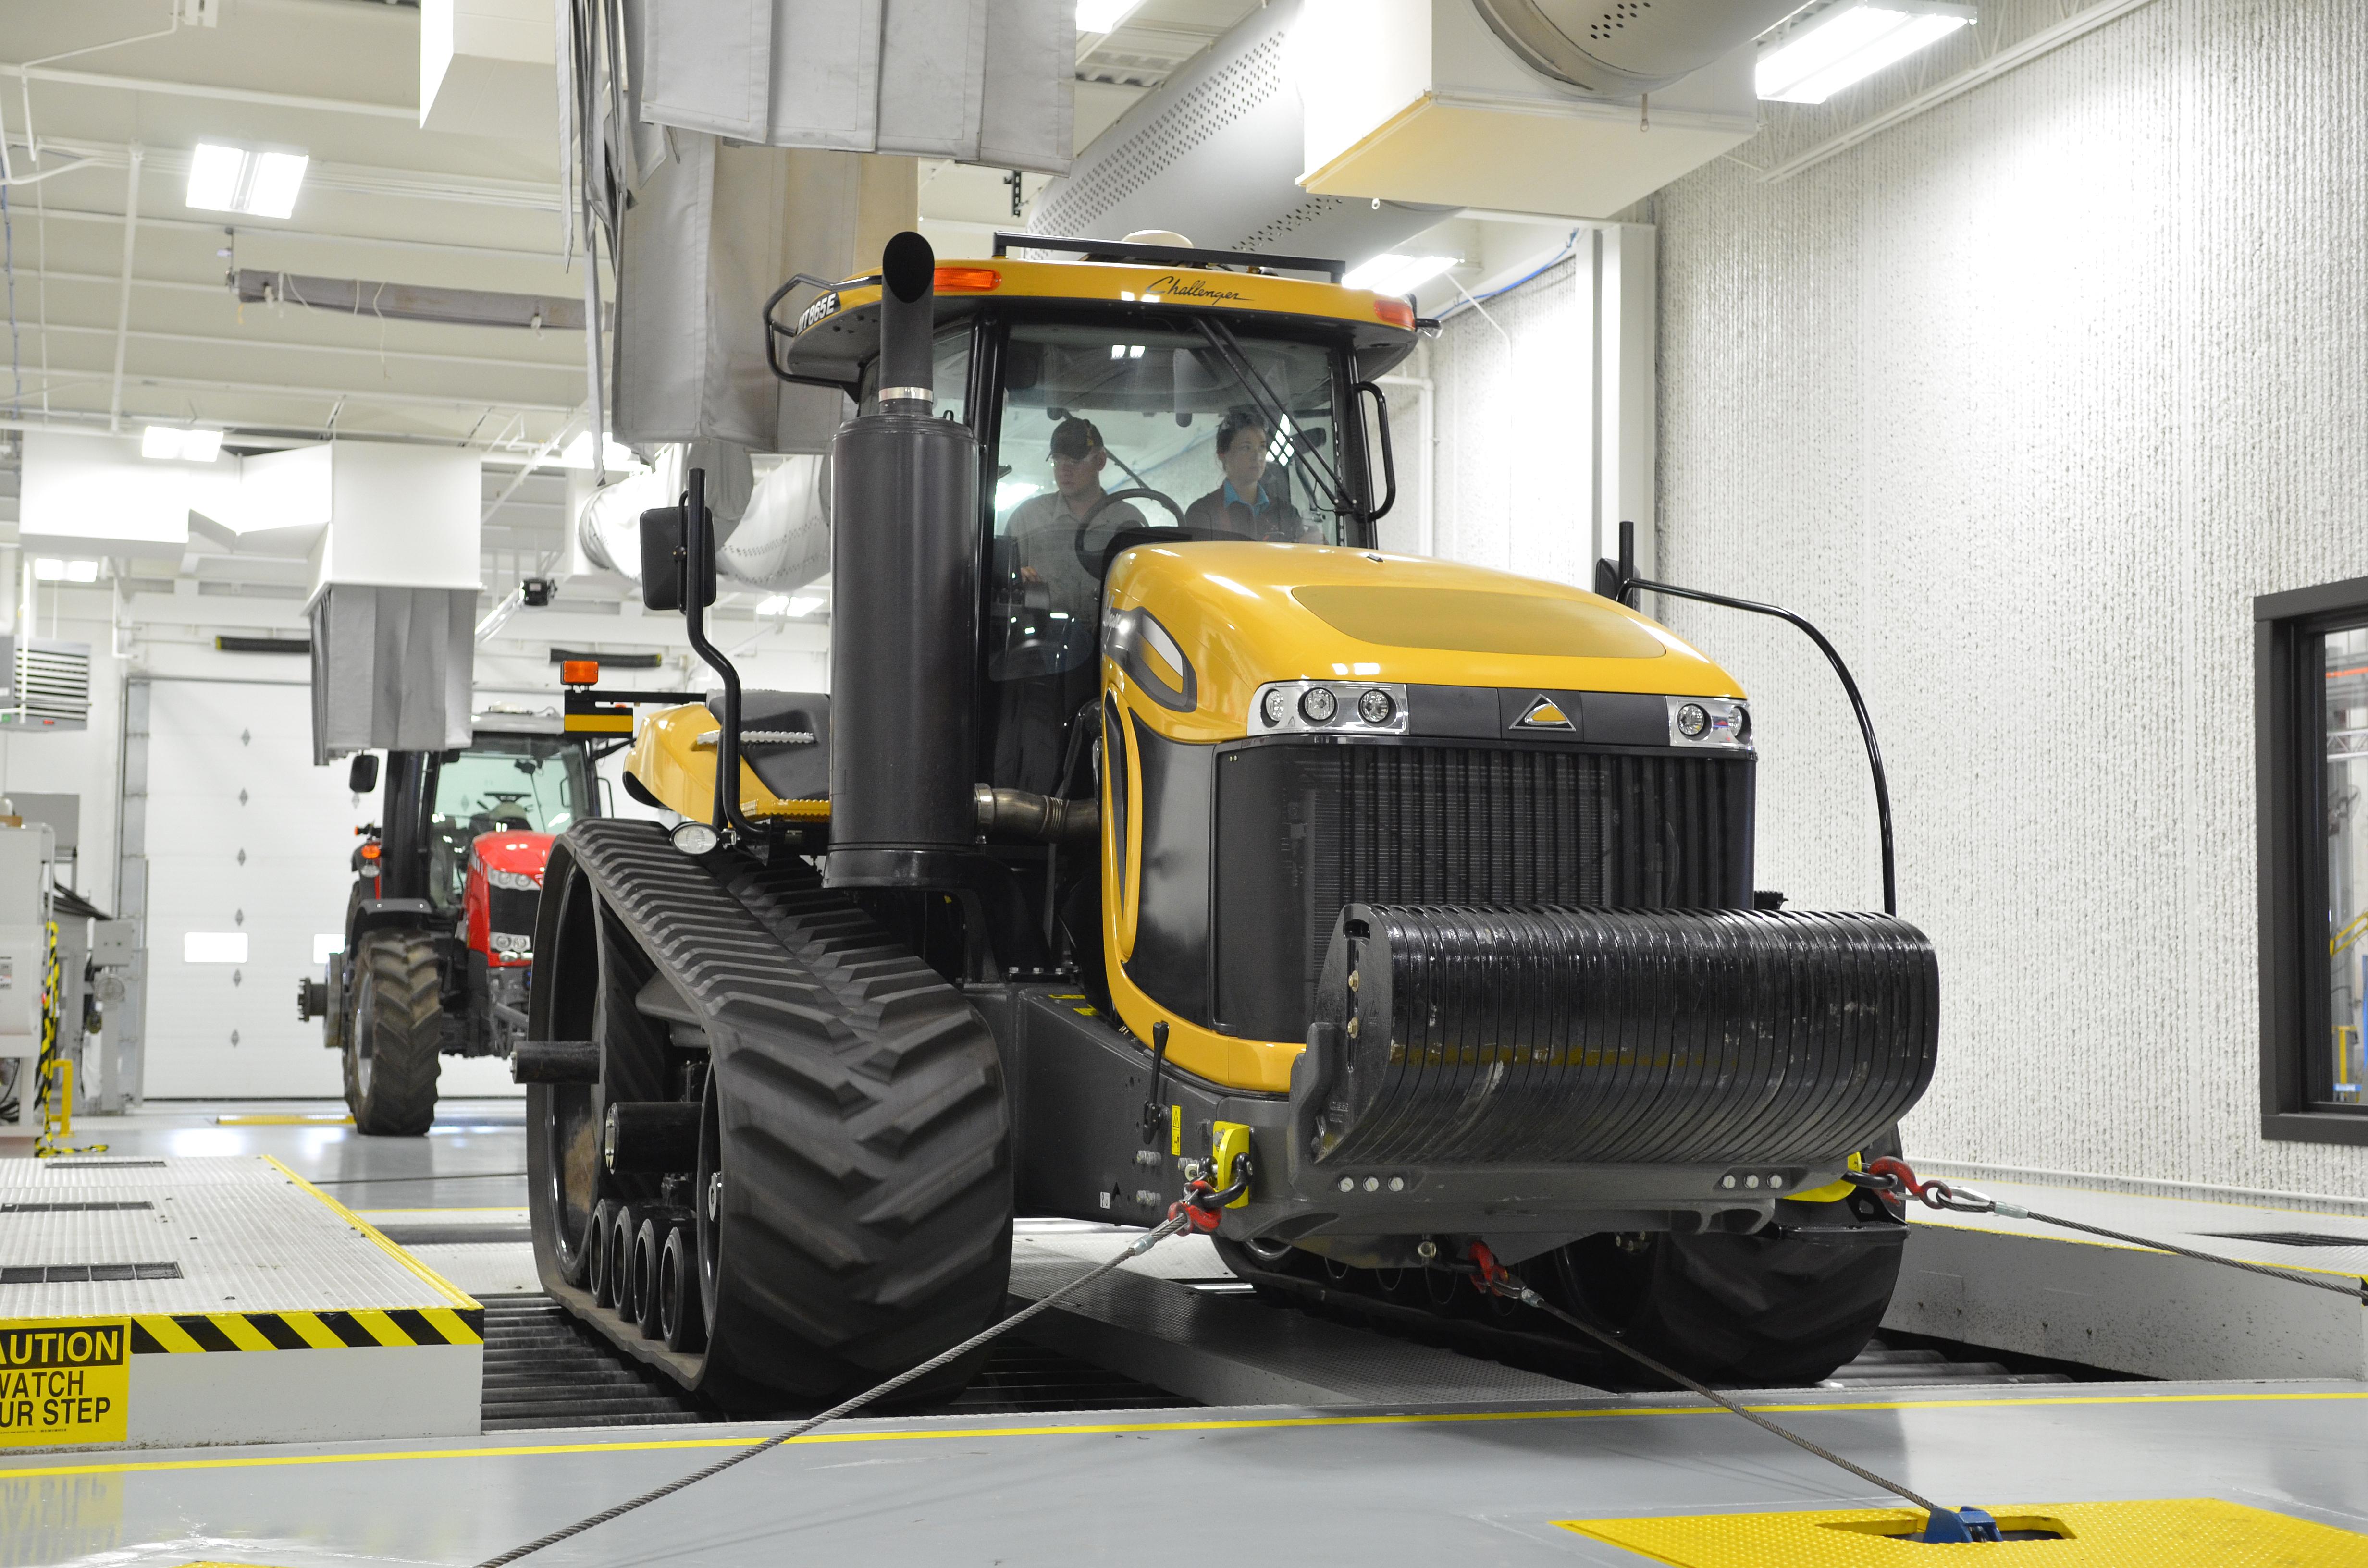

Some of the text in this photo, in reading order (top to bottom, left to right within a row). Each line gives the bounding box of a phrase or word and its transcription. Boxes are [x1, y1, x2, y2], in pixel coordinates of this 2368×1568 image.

[1146, 276, 1255, 305] Challenger
[0, 1331, 118, 1365] UTION
[43, 1397, 111, 1425] STEP
